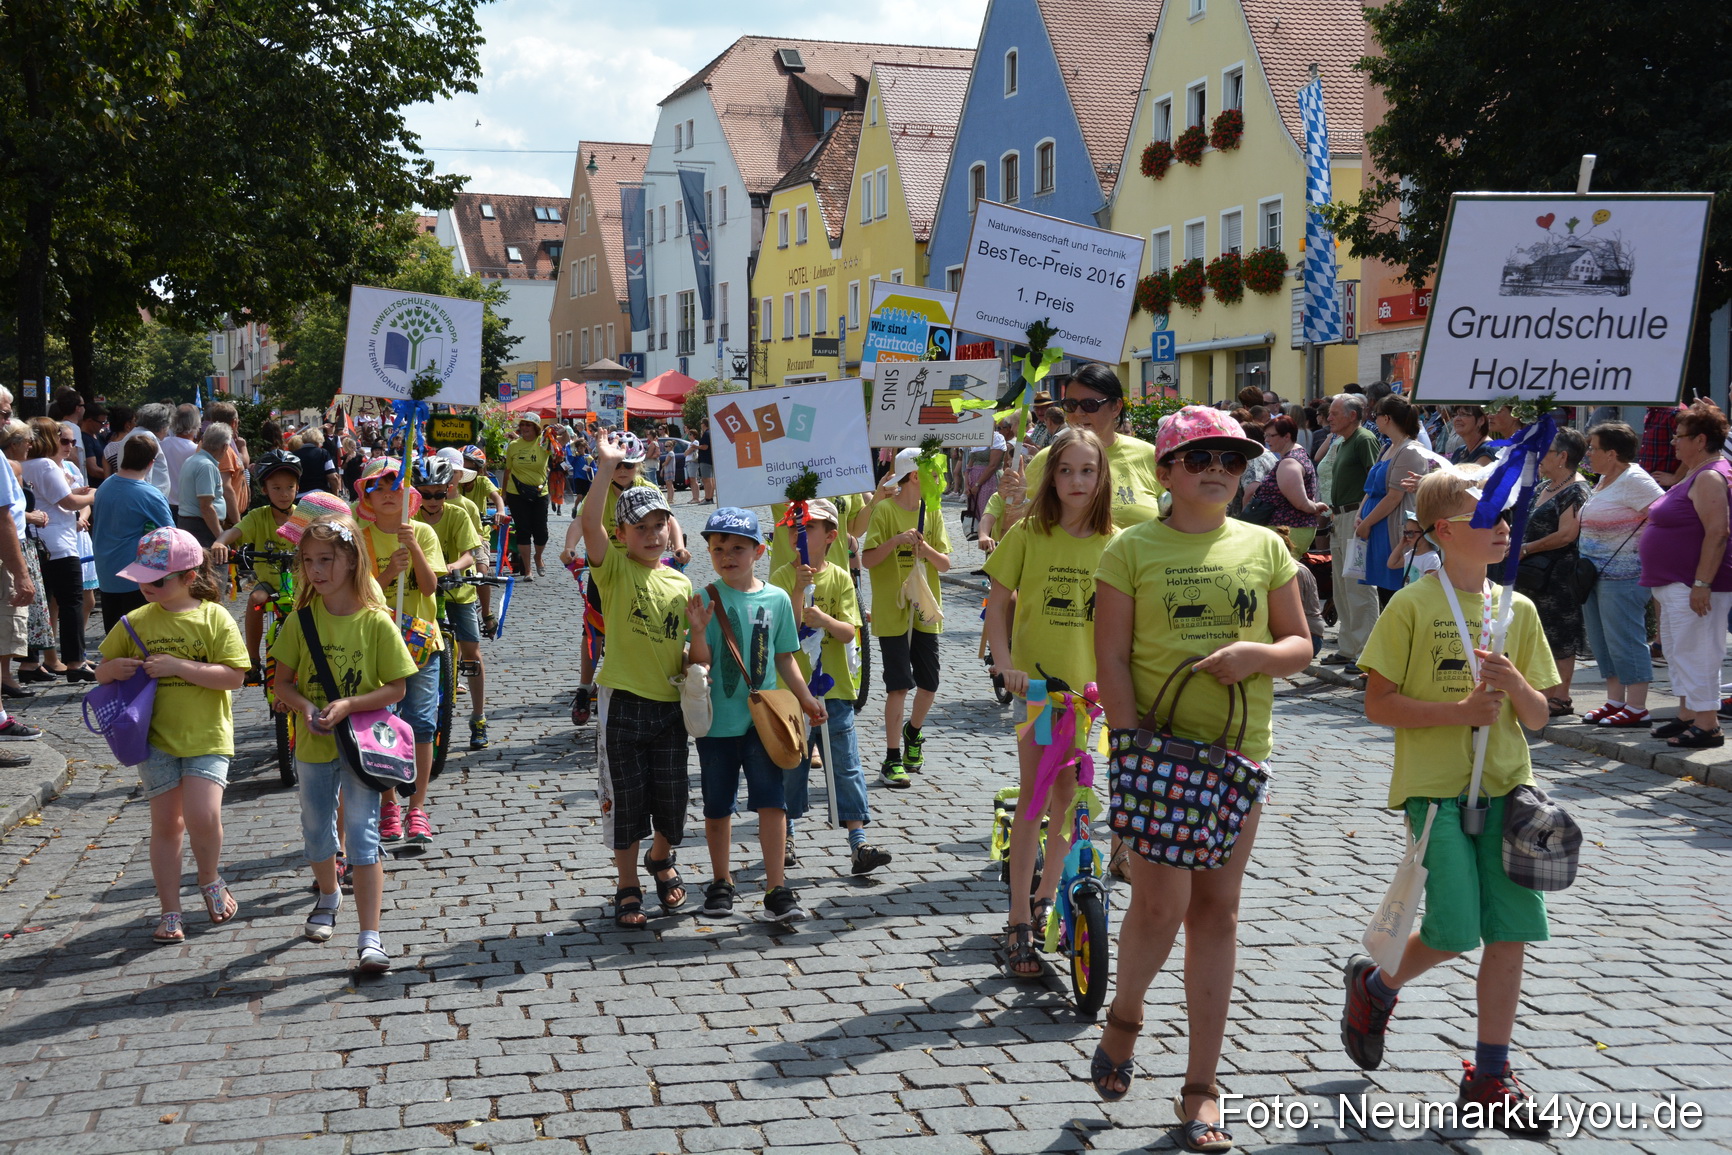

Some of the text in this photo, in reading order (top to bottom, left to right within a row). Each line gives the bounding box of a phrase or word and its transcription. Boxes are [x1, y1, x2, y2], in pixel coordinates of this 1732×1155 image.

[987, 218, 1127, 260] Naturwissenschaft und Technik
[978, 240, 1126, 289] BesTec-Preis 2016
[788, 266, 809, 286] HOTEL
[1017, 287, 1075, 313] 1. Preis
[1346, 283, 1354, 339] KINO
[1378, 303, 1392, 319] DER
[371, 297, 458, 344] UMWELTSCHULE IN EUROPA
[871, 320, 907, 335] Wir sind
[1447, 306, 1669, 340] Grundschule
[867, 333, 924, 353] Fairtrade
[1058, 329, 1102, 348] Oberpfalz
[1157, 335, 1170, 359] P
[368, 339, 405, 394] INTERNATIONALE
[786, 358, 815, 371] Restaurant
[1468, 358, 1632, 390] Holzheim
[881, 369, 900, 411] SINUS
[441, 419, 465, 428] Schule
[731, 413, 807, 433] B S S
[436, 430, 469, 438] Wolfstein
[884, 432, 985, 441] Wir sind SINUSSCHULE
[745, 441, 752, 460] i
[765, 455, 837, 473] Bildung durch
[835, 463, 869, 478] Schrift
[723, 514, 751, 529] York
[1048, 565, 1090, 576] Grundschule
[1165, 564, 1224, 575] Grundschule
[1048, 575, 1079, 584] Holzheim
[1166, 576, 1212, 587] Holzheim
[1181, 631, 1239, 640] Umweltschule
[1434, 631, 1474, 639] Holzhm
